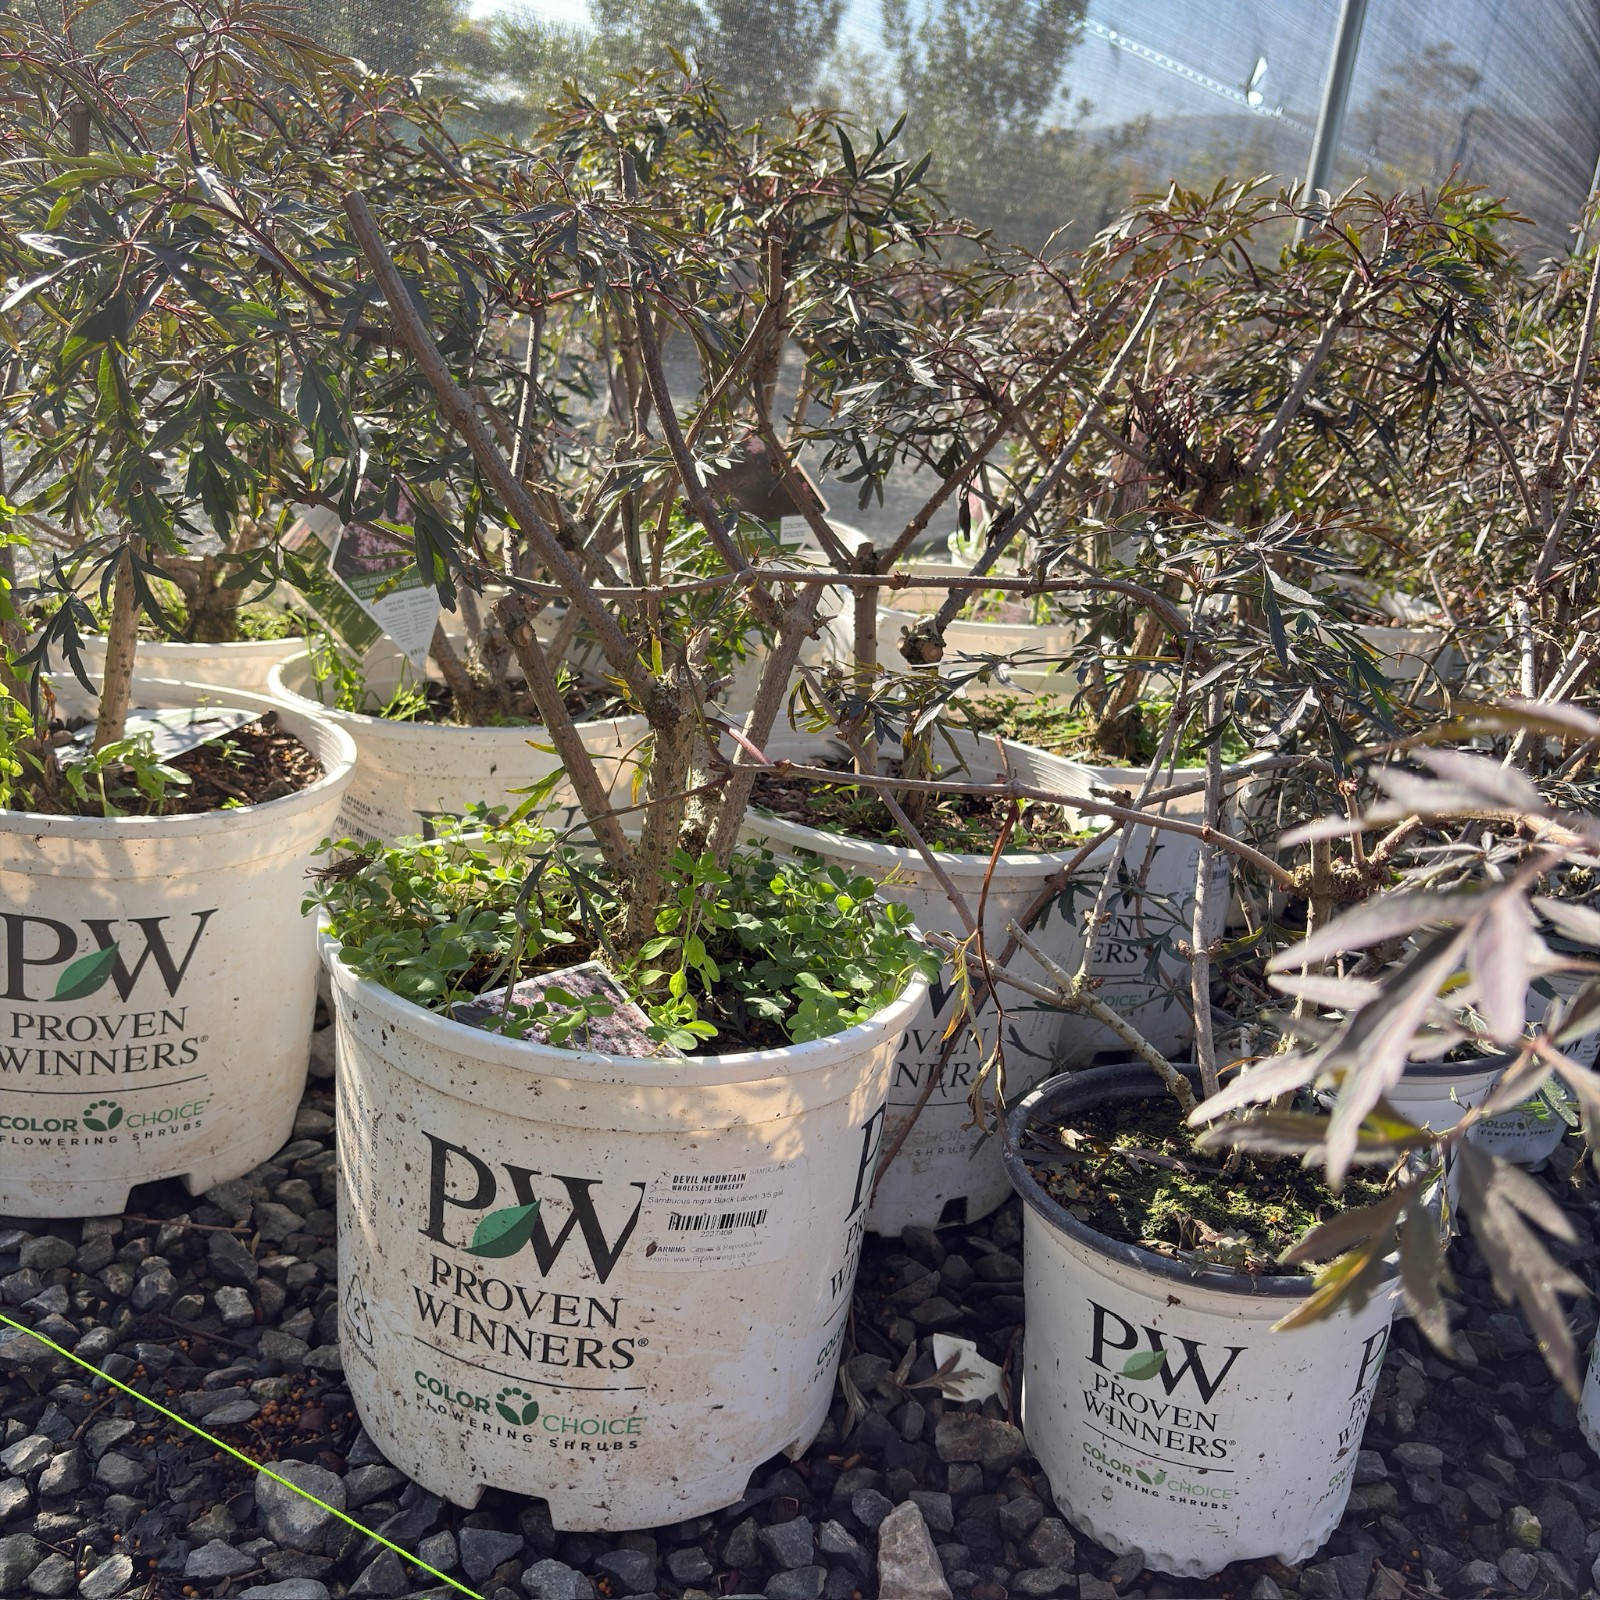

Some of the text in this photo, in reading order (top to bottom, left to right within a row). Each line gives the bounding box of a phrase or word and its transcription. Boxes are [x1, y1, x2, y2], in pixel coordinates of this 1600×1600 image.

[0, 908, 219, 1003] PW
[9, 1006, 189, 1042] PROVEN
[0, 1101, 206, 1132] COLOR CHOICE
[0, 1120, 203, 1147] FLOWERING SHRUBS
[418, 1130, 646, 1284] PW
[648, 1196, 690, 1205] Sambucus
[692, 1196, 712, 1206] nigra
[714, 1196, 735, 1204] Black
[671, 1183, 744, 1192] WHOLESALE NURSERY
[673, 1173, 747, 1184] DEVIL MOUNTAIN
[429, 1253, 623, 1329] PROVEN
[1086, 1299, 1249, 1404] PW
[414, 1370, 644, 1436] COLOR CHOICE
[416, 1393, 639, 1450] FLOWERING SHRUBS
[1094, 1372, 1220, 1432] PROVEN
[1082, 1442, 1233, 1499] COLOR CHOICE
[1082, 1456, 1229, 1510] FLOWERING SHRUBS
